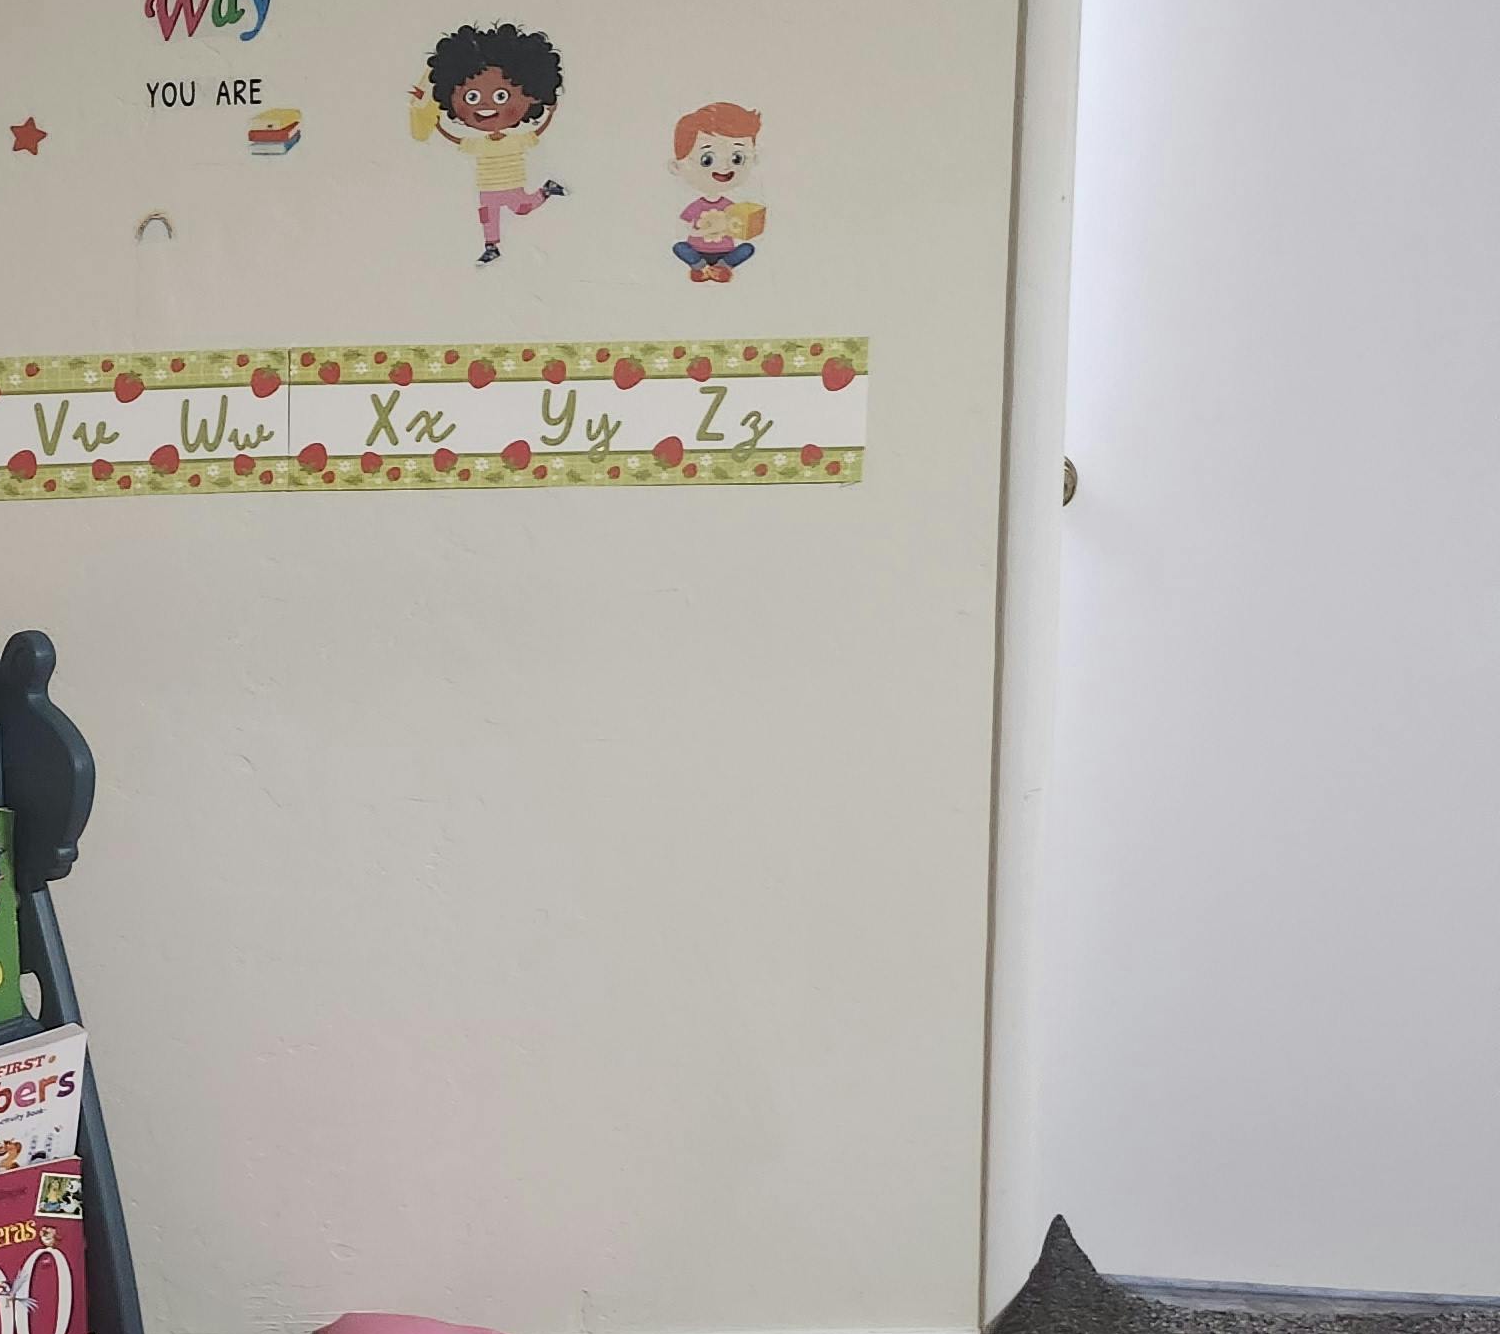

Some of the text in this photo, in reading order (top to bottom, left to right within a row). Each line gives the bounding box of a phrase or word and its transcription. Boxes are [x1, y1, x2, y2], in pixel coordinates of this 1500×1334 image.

[146, 79, 262, 108] YOU ARE
[34, 400, 120, 456] Vv
[180, 395, 274, 453] Ww
[366, 390, 456, 447] Xx
[541, 388, 622, 462] Yy
[695, 386, 773, 462] Zz
